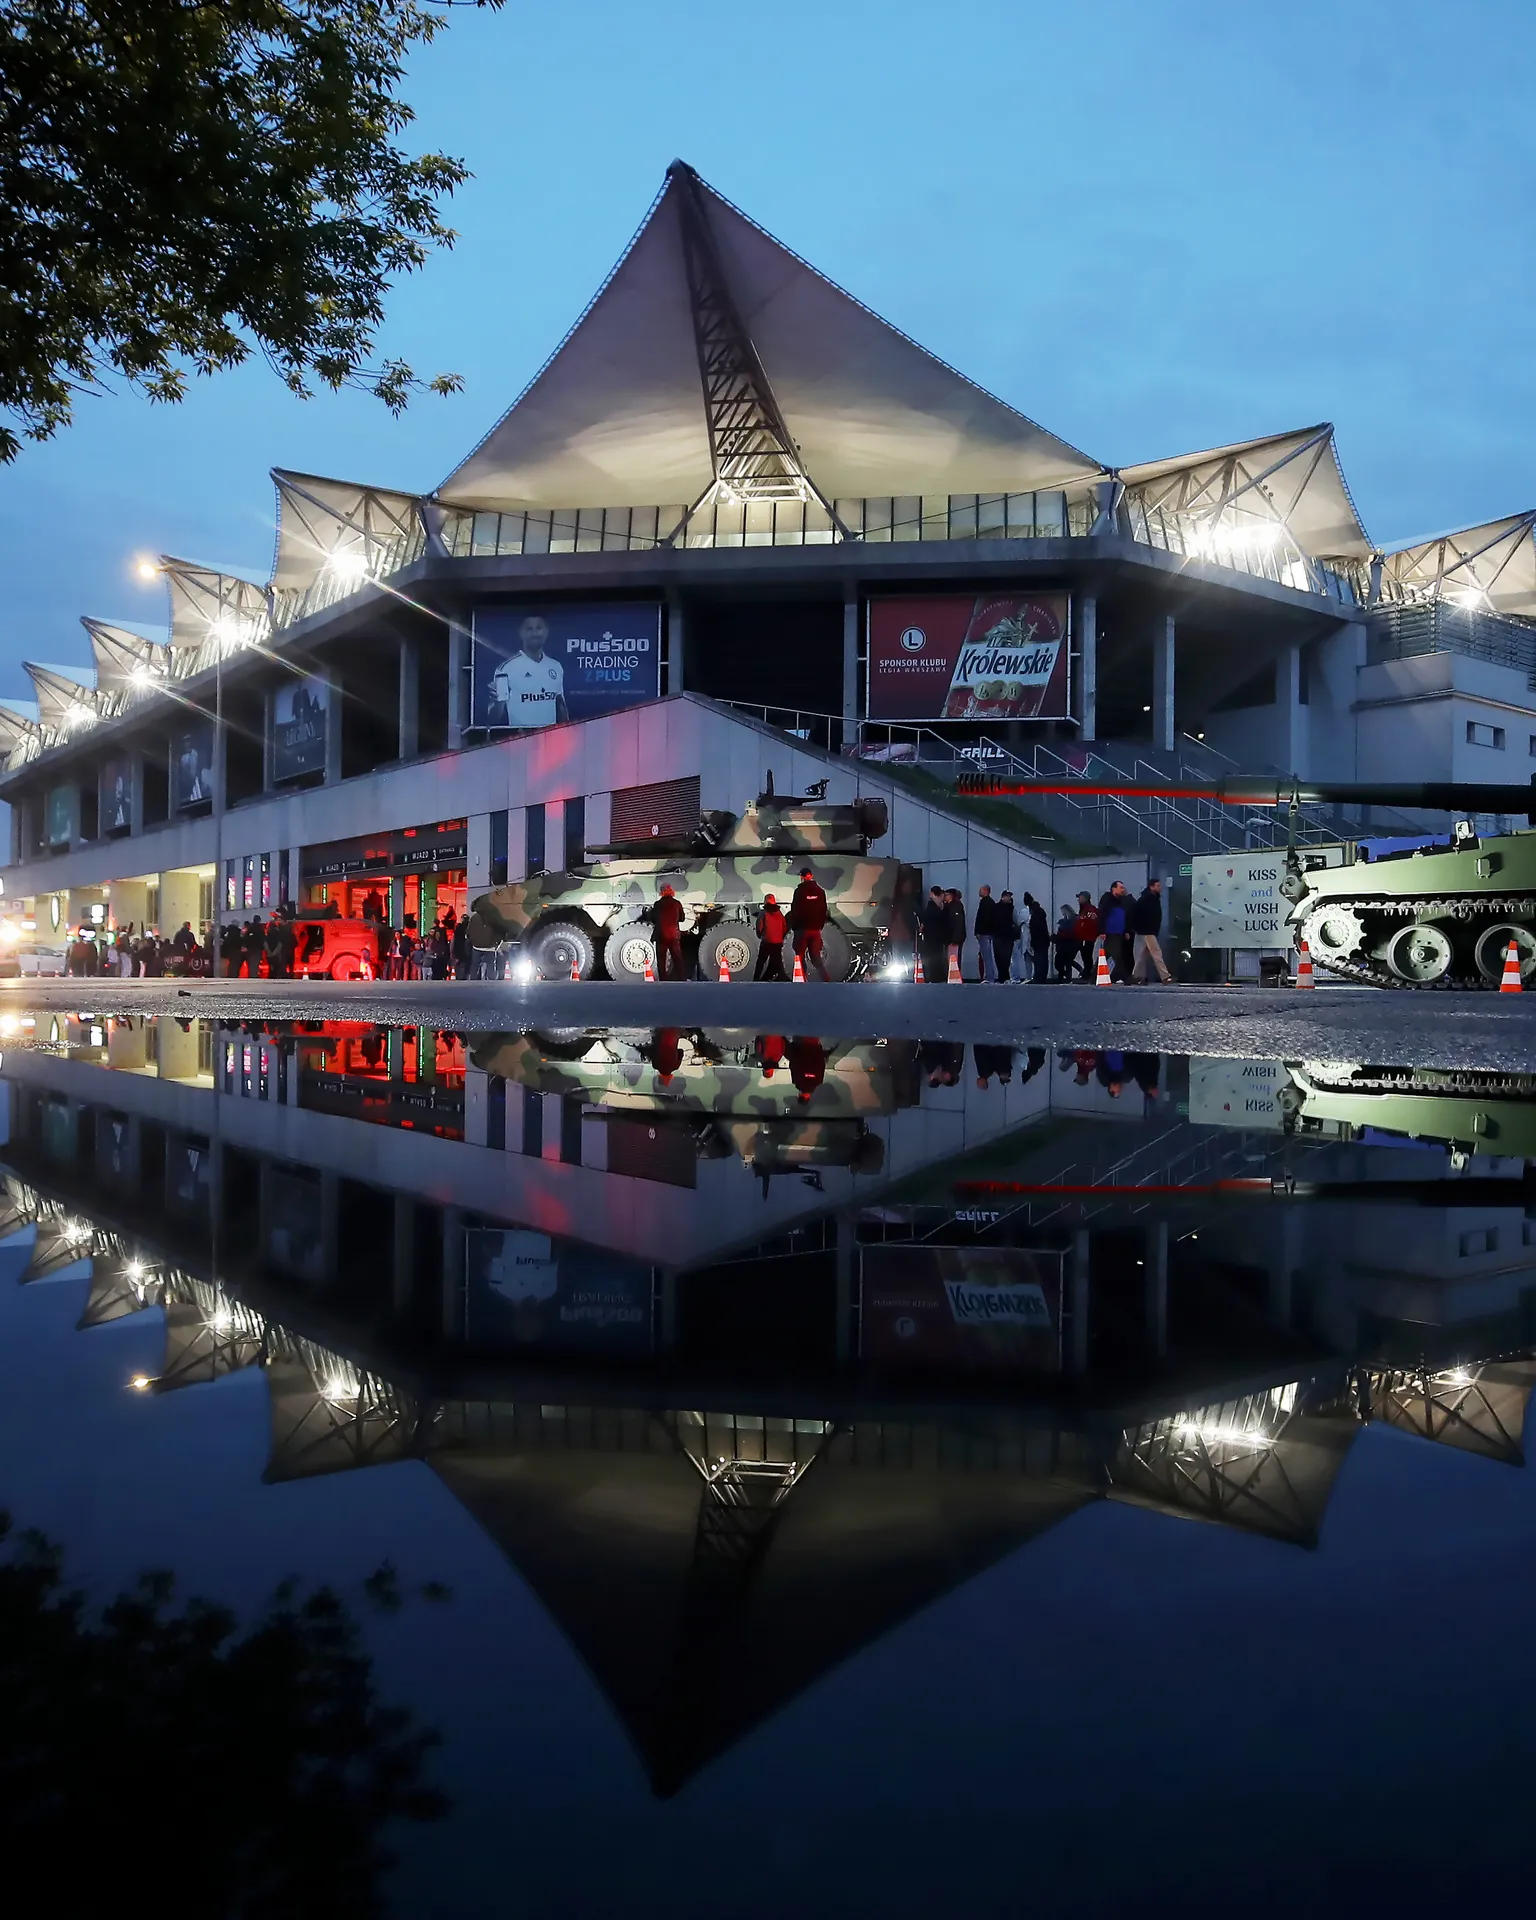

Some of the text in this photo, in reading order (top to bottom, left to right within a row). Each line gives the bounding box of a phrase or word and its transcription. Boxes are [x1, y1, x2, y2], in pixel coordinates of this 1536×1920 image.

[566, 634, 650, 653] Plus500
[576, 655, 639, 669] TRADING
[879, 658, 947, 667] SPONSOR KLUBU
[956, 646, 1053, 682] Królewskie
[596, 669, 632, 682] PLUS
[960, 747, 1005, 758] GRILL
[1248, 869, 1277, 881] KISS
[1251, 886, 1273, 898] and
[1244, 903, 1279, 914] WISH
[1244, 920, 1279, 931] LUCK
